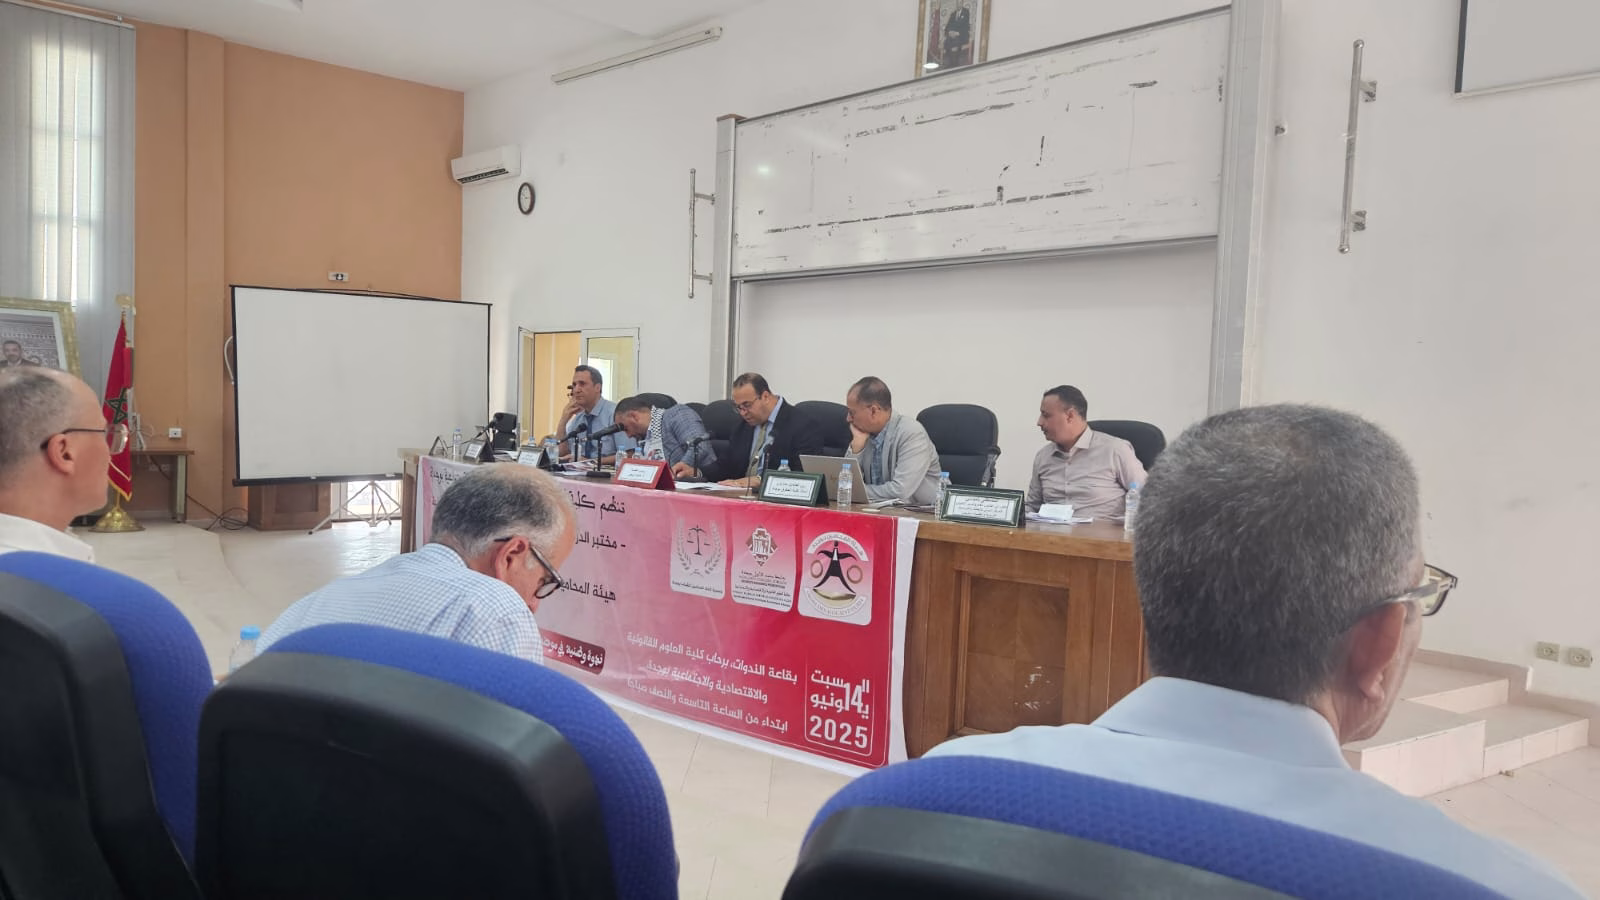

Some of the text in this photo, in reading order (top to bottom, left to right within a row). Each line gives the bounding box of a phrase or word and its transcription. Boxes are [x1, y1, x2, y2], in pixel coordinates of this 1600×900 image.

[600, 496, 625, 520] تنظم
[592, 534, 617, 549] مختبر
[561, 578, 616, 603] هيئة المحامي
[627, 631, 658, 648] القانونية
[659, 642, 683, 654] العلوم
[686, 646, 704, 660] كلية
[706, 652, 729, 669] برحاب
[672, 667, 714, 690] والاجتماعية
[768, 667, 798, 685] بقاعة
[649, 685, 676, 704] والنصف
[716, 680, 768, 704] والاقتصادية
[678, 694, 710, 711] التاسعة
[713, 703, 742, 720] الساعة
[745, 713, 759, 724] من
[810, 715, 868, 748] 2025
